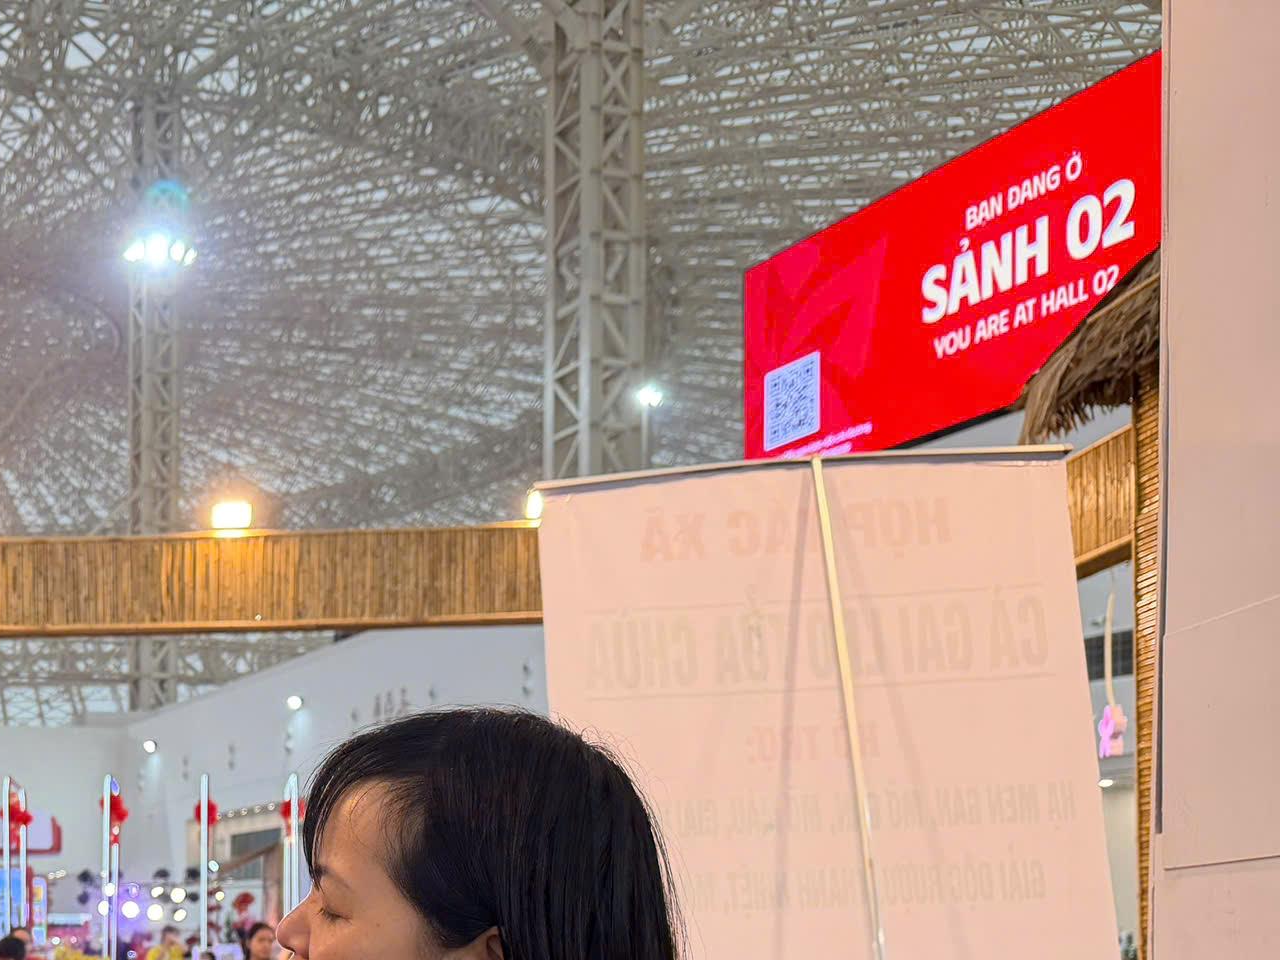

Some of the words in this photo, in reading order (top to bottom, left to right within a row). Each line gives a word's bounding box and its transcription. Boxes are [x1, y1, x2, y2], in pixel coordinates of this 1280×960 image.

[921, 215, 1049, 324] SẢNH
[1066, 178, 1136, 260] 02
[933, 326, 970, 359] YOU
[974, 309, 1010, 345] ARE
[1014, 298, 1037, 329] AT
[1040, 278, 1088, 318] HALL
[1093, 264, 1120, 296] 02
